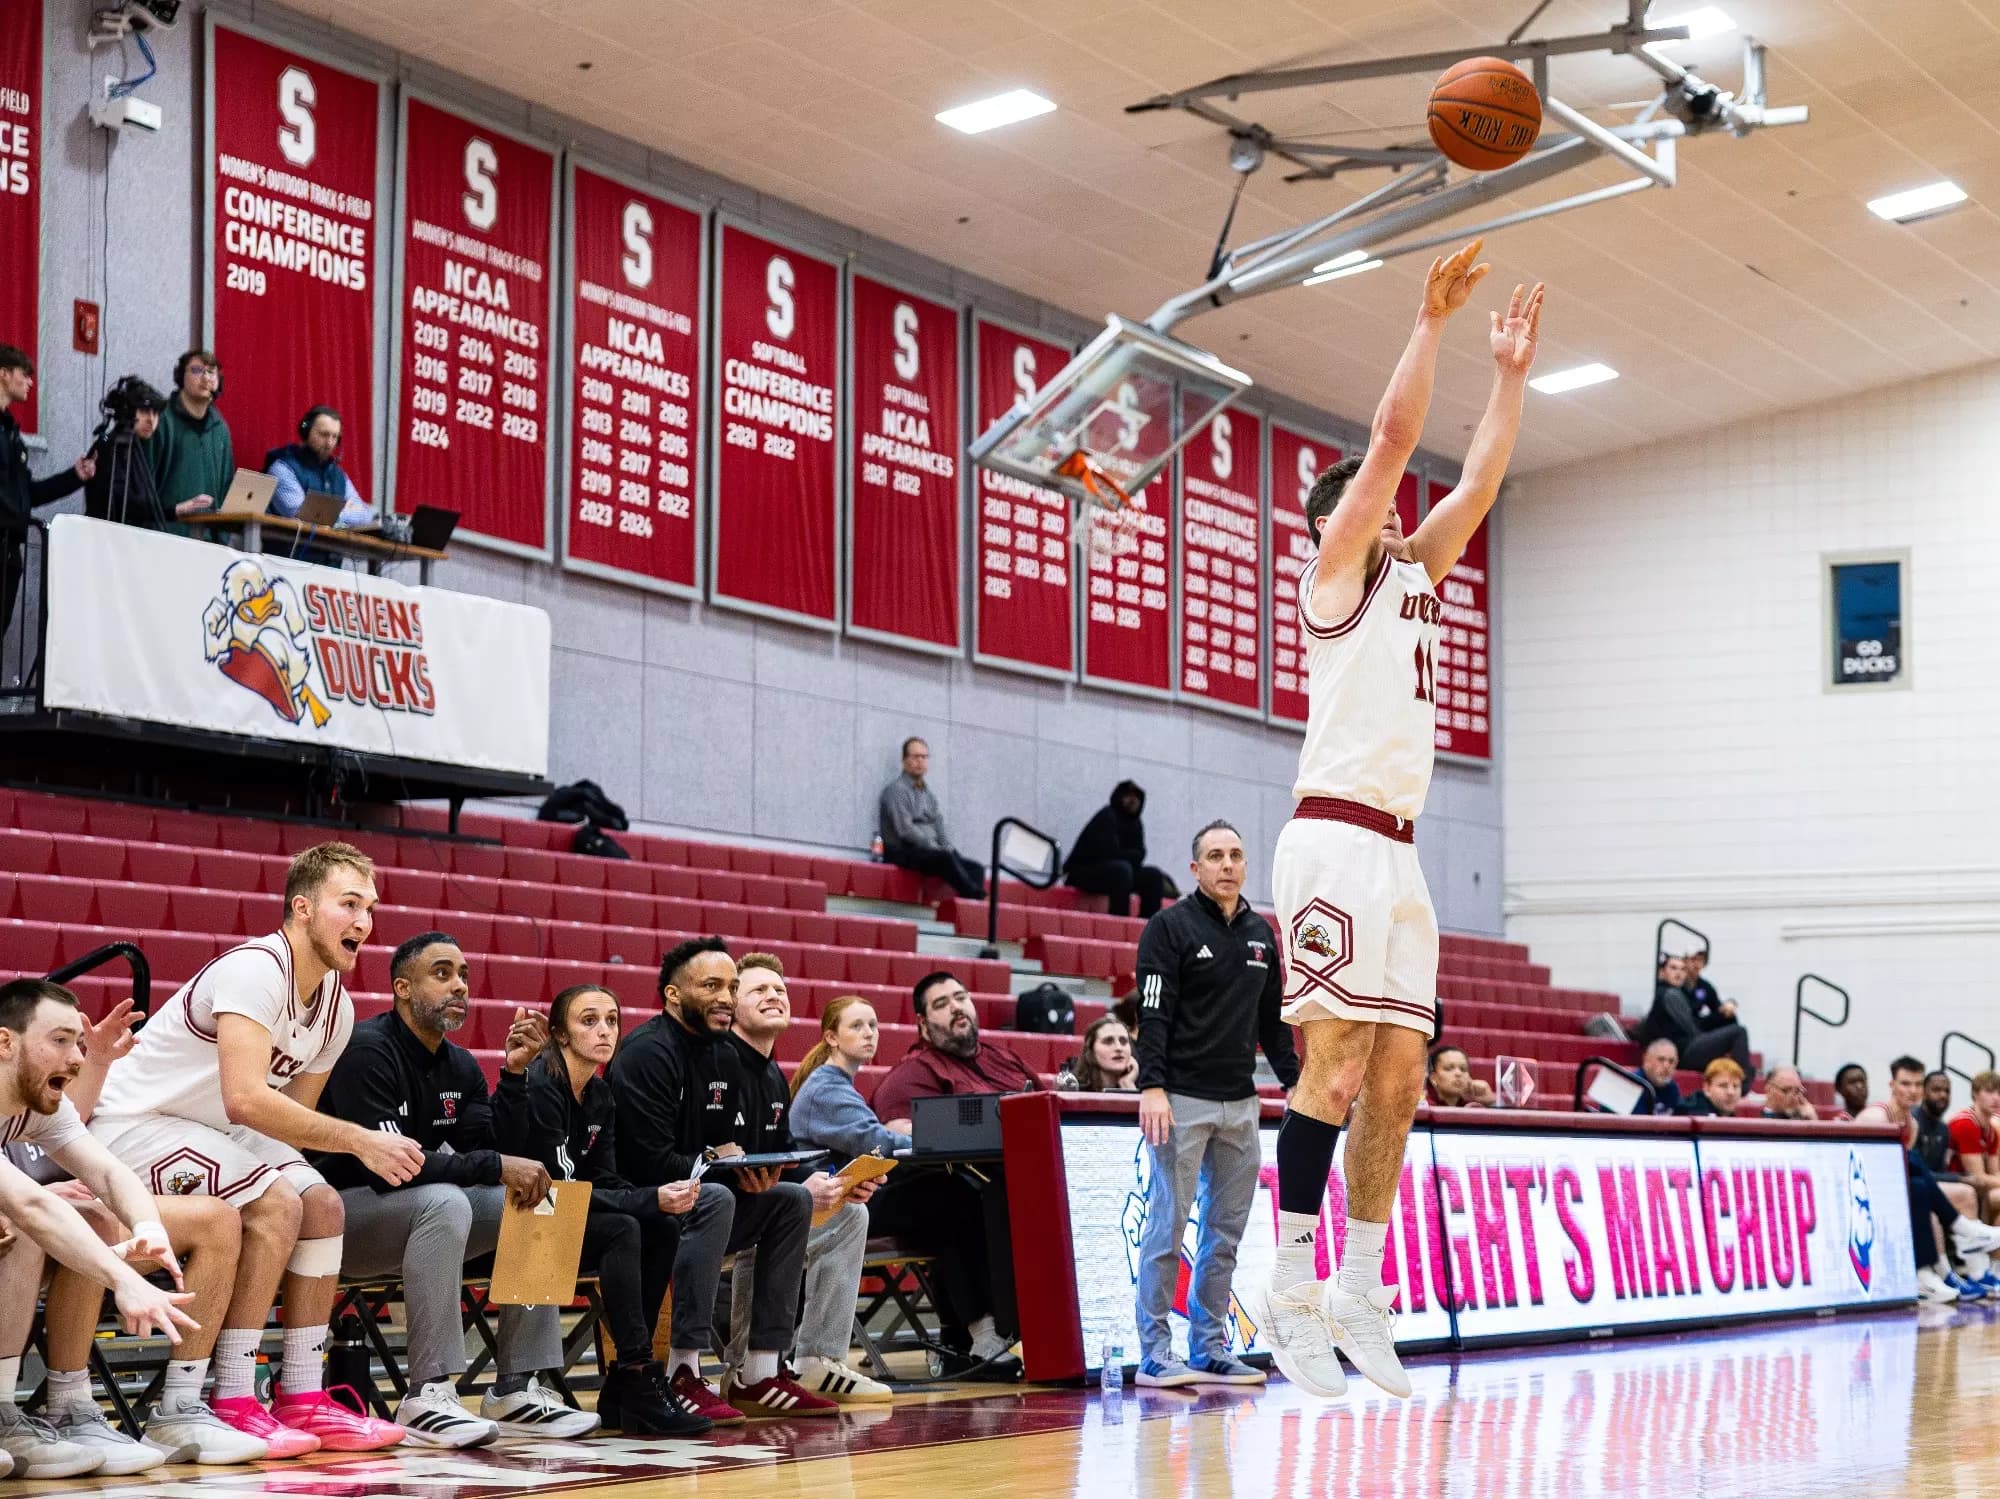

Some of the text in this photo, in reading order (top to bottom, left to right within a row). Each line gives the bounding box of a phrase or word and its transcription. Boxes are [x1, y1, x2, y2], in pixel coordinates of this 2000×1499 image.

[0, 87, 30, 115] FIELD
[279, 66, 316, 168] S
[219, 153, 267, 188] WOMEN'S
[266, 166, 309, 201] OUTDOOR
[309, 179, 339, 210] TRACK
[347, 193, 372, 220] FIELD
[463, 137, 498, 231] S
[225, 187, 365, 256] CONFERENCE
[622, 202, 654, 288] S
[225, 221, 365, 291] CHAMPIONS
[226, 263, 267, 297] 2019
[444, 259, 510, 312] NCAA
[766, 257, 795, 339] S
[412, 286, 539, 349] APPEARANCES
[608, 317, 664, 364] NCAA
[894, 303, 919, 381] S
[413, 320, 538, 380] 2013 2014 2015
[579, 343, 690, 398] APPEARANCES
[751, 340, 807, 375] SOFTBALL
[1013, 346, 1036, 408] S
[414, 353, 537, 411] 2016 2017 2018
[725, 358, 833, 414] CONFERENCE
[411, 418, 450, 450] 2024
[412, 385, 538, 443] 2019 2022 2023
[724, 387, 833, 442] CHAMPIONS
[882, 407, 931, 449] NCAA
[763, 433, 796, 460] 2022
[862, 432, 954, 478] APPEARANCES
[1211, 413, 1233, 480] S
[303, 583, 423, 649] STEVENS
[312, 636, 436, 717] DUCKS
[1842, 655, 1897, 675] DUCKS
[1856, 639, 1883, 657] GO
[1596, 1157, 1816, 1301] MATCHUP
